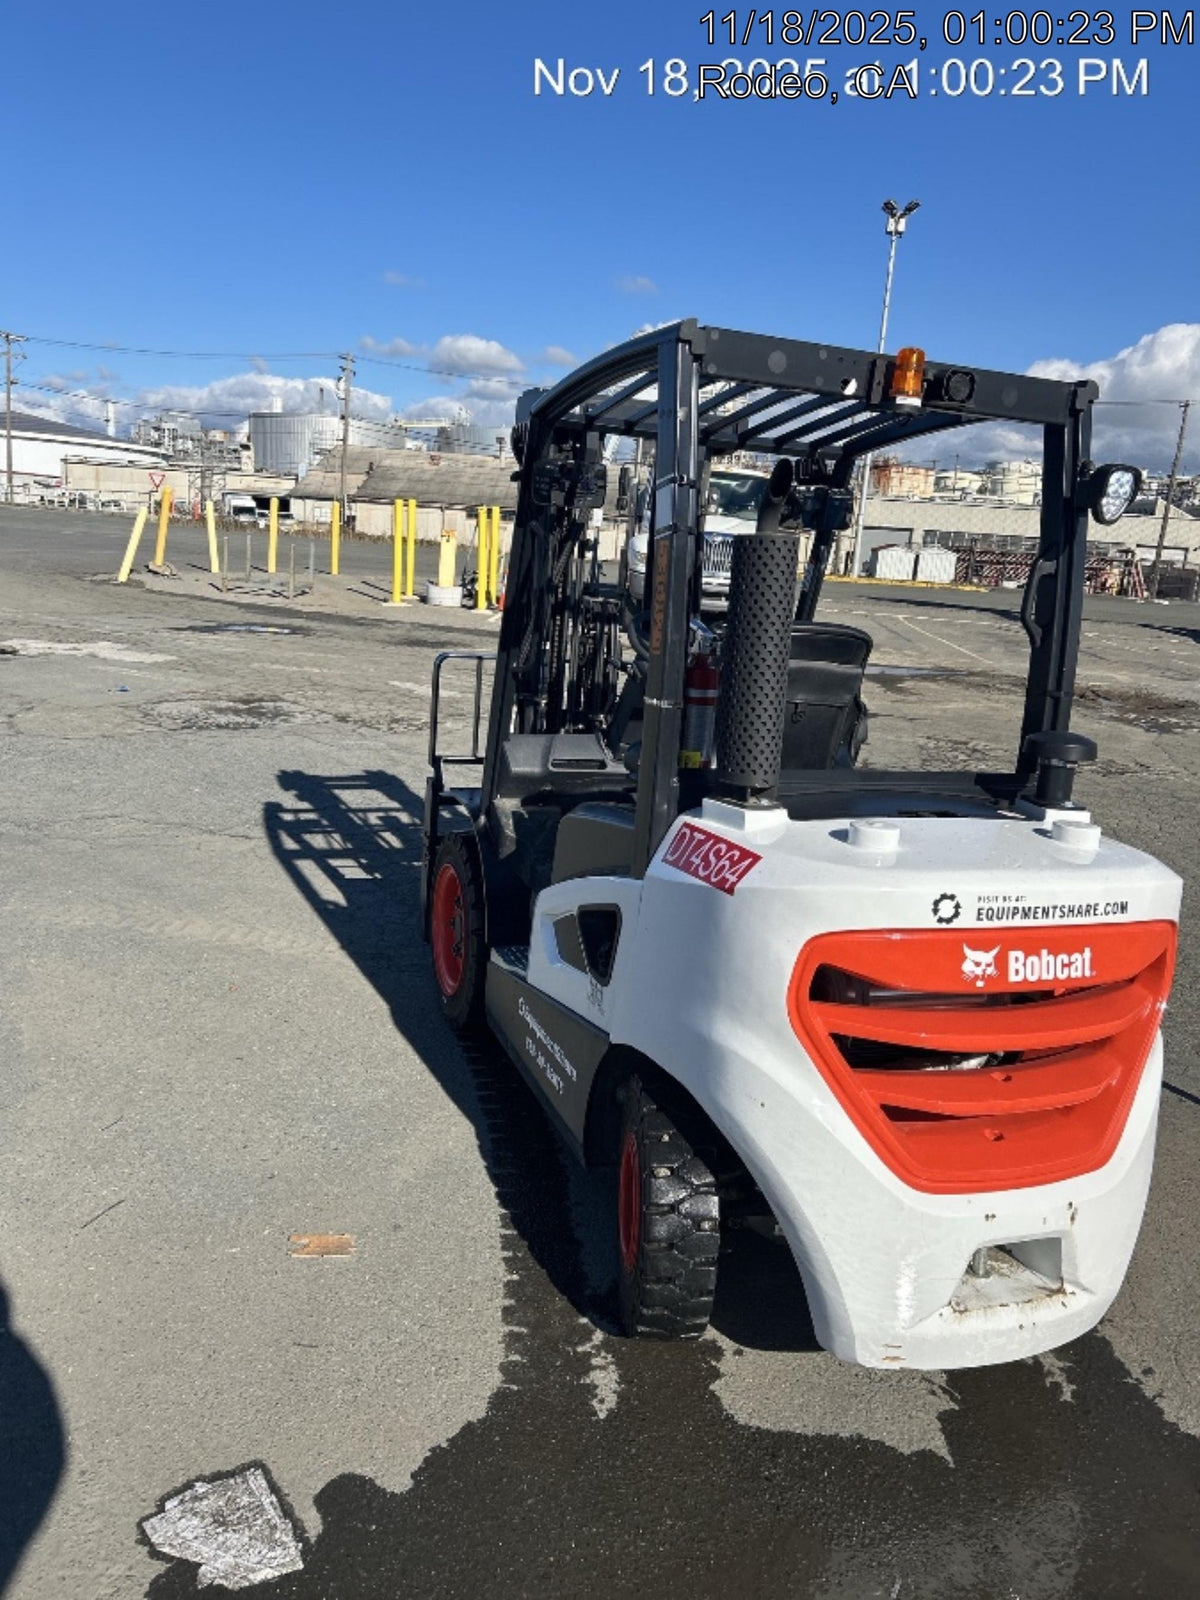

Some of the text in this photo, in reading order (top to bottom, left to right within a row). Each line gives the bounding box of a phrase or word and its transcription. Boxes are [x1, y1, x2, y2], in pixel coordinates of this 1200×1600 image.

[666, 826, 754, 889] DT4S64
[976, 900, 1129, 922] EQUIPMENTSHARE.COM
[1007, 946, 1092, 983] Bobcat
